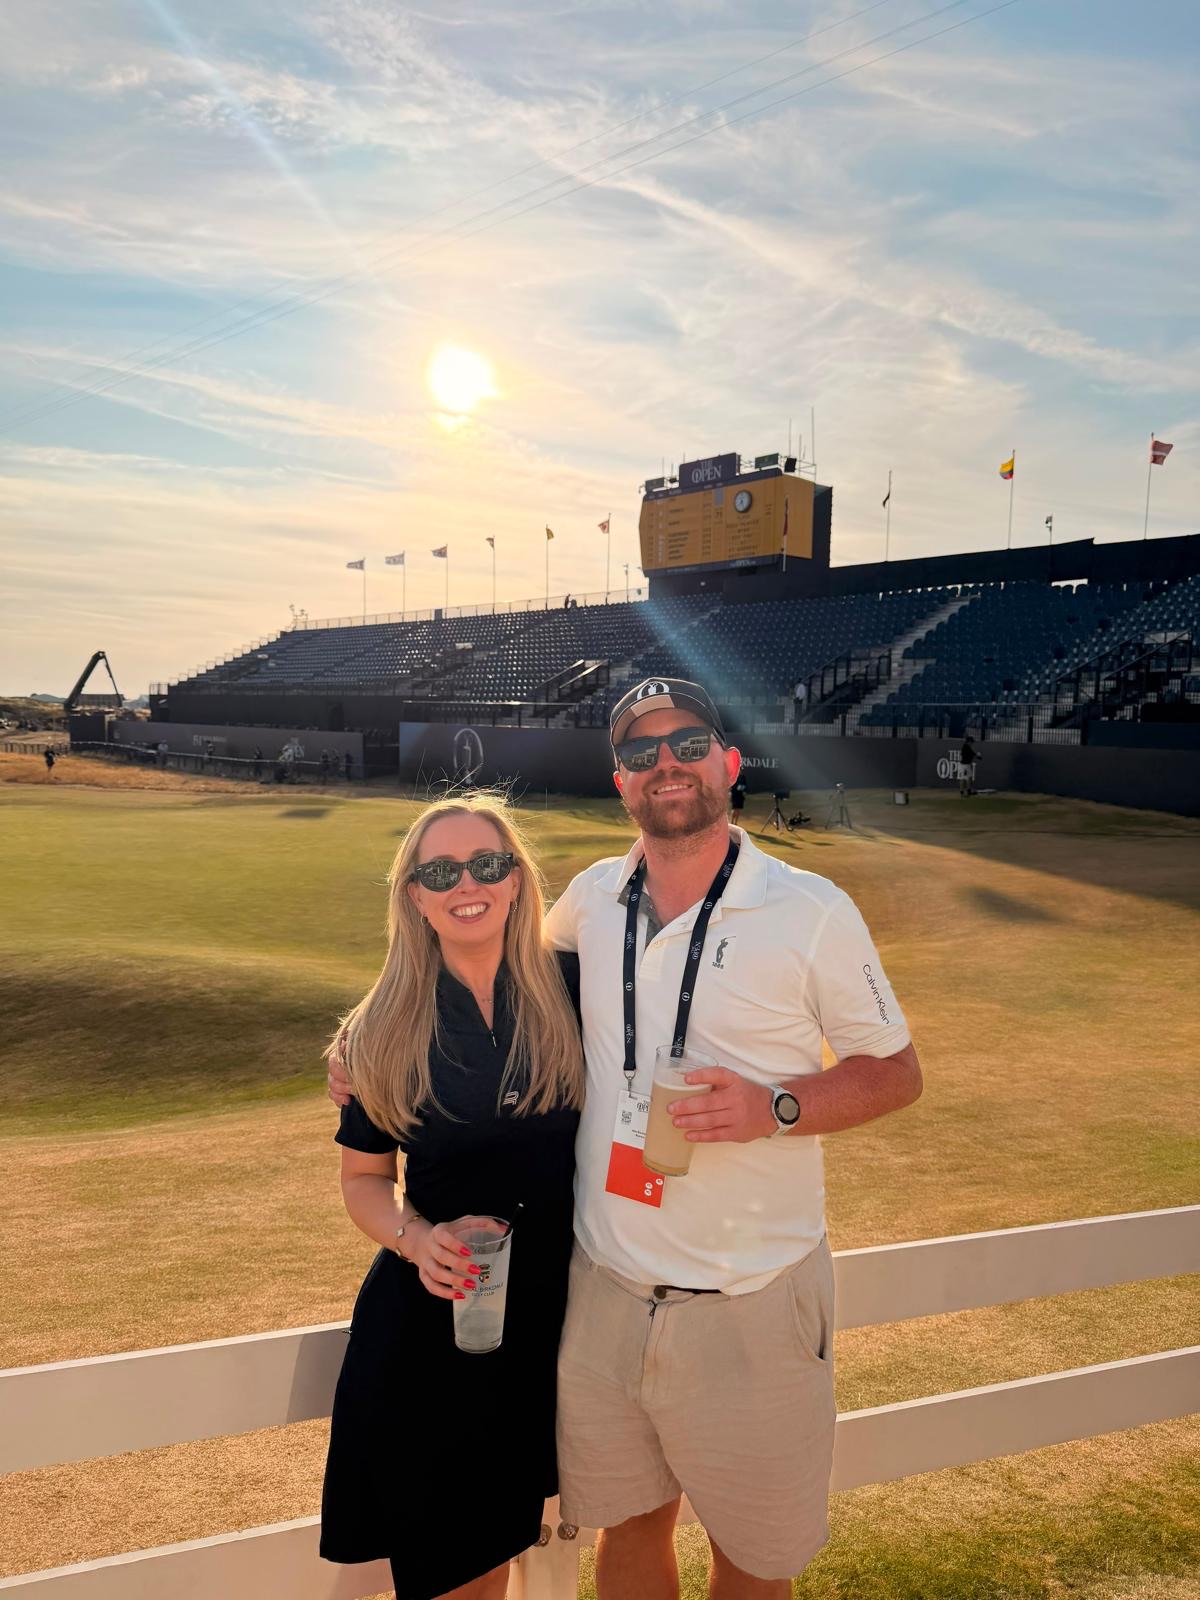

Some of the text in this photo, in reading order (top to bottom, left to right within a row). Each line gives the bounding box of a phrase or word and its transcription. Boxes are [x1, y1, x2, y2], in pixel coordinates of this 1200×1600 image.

[691, 465, 722, 484] OPEN
[742, 756, 780, 769] RKDALE
[948, 750, 962, 761] TH
[863, 964, 890, 1025] Calvin Klein
